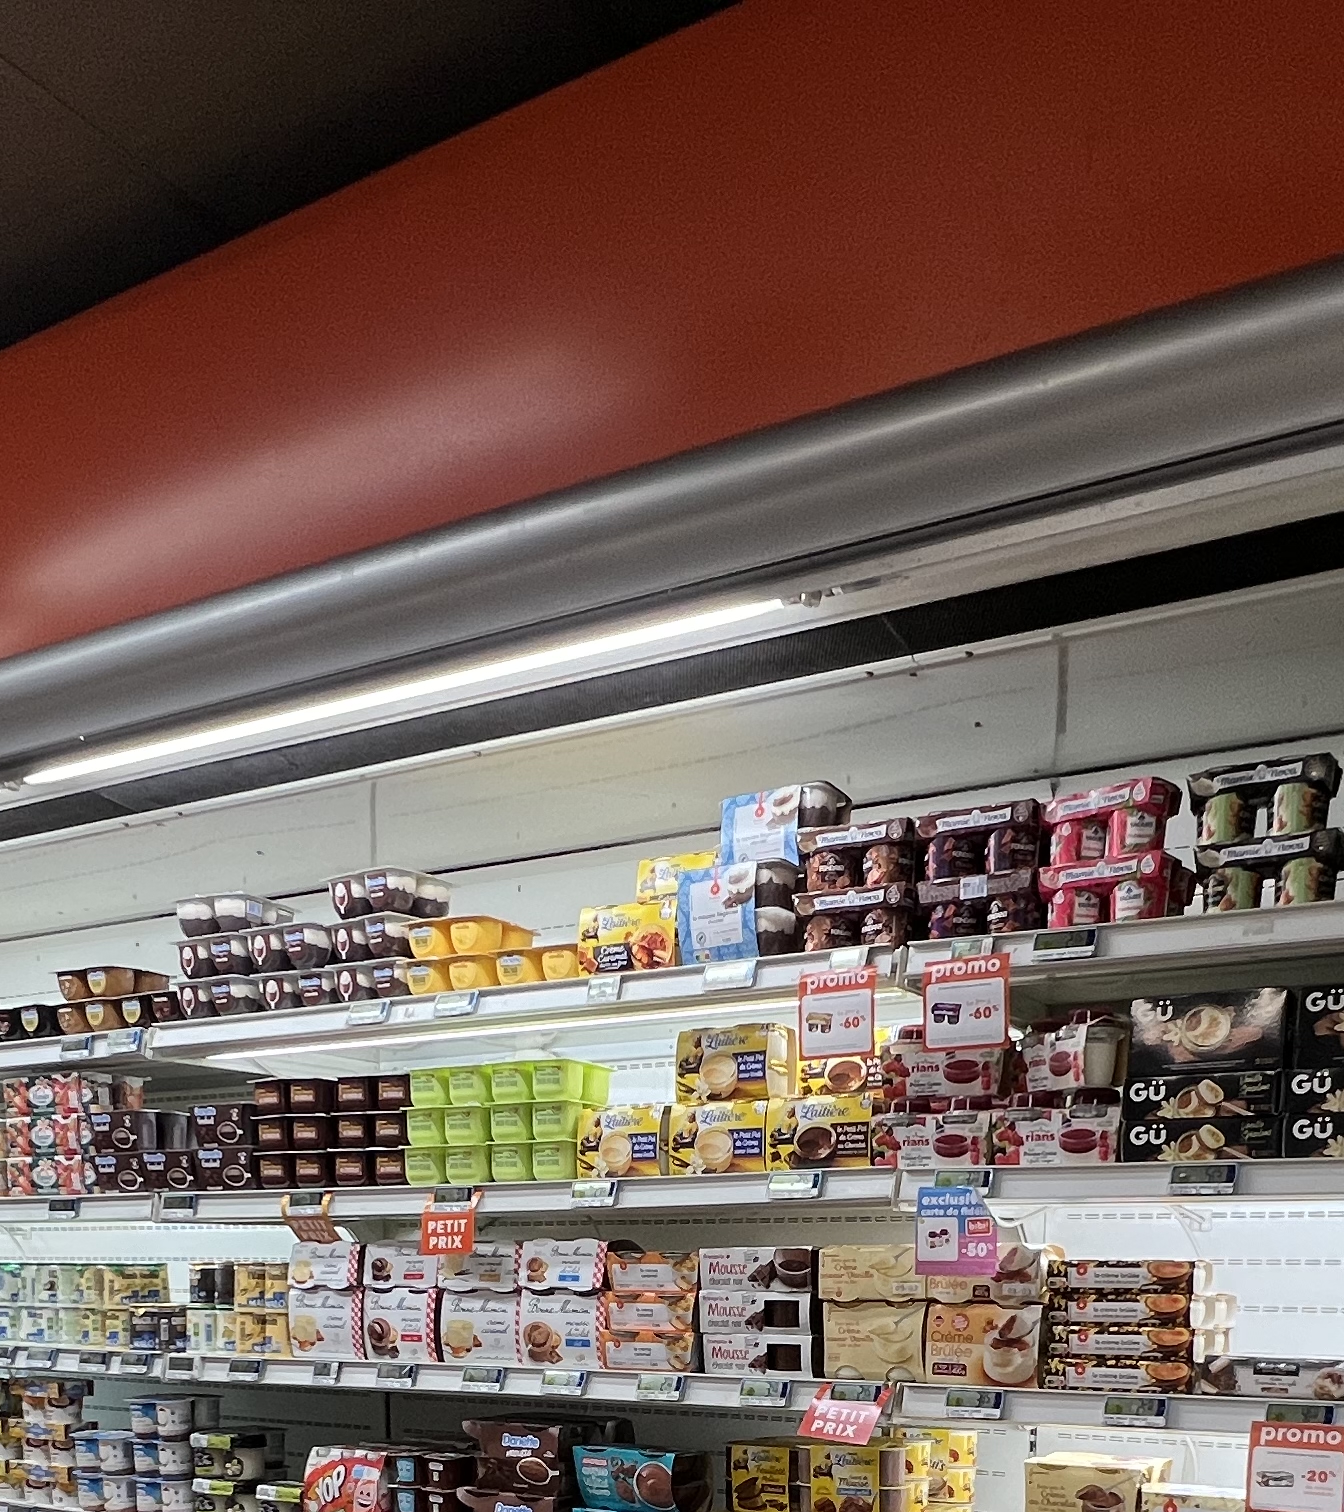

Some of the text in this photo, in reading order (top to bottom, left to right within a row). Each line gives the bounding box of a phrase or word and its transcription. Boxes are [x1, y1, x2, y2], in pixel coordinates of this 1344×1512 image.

[931, 958, 1001, 983] promo
[806, 971, 869, 994] promo
[911, 1062, 939, 1072] rians
[1291, 1069, 1332, 1094] Gü
[1129, 1080, 1166, 1101] Gü
[1129, 1125, 1167, 1145] Gü
[1293, 1116, 1333, 1139] Gü
[903, 1137, 929, 1147] rians
[1026, 1132, 1055, 1141] rians
[428, 1219, 467, 1233] PETIT
[429, 1235, 462, 1249] PRIX
[709, 1262, 747, 1275] Mousse
[708, 1303, 746, 1317] Mousse
[712, 1347, 749, 1360] Mousse
[814, 1405, 869, 1423] PETIT
[811, 1420, 858, 1437] PRIX
[1260, 1426, 1342, 1445] promo
[502, 1433, 539, 1448] Danette
[315, 1465, 346, 1505] YOP
